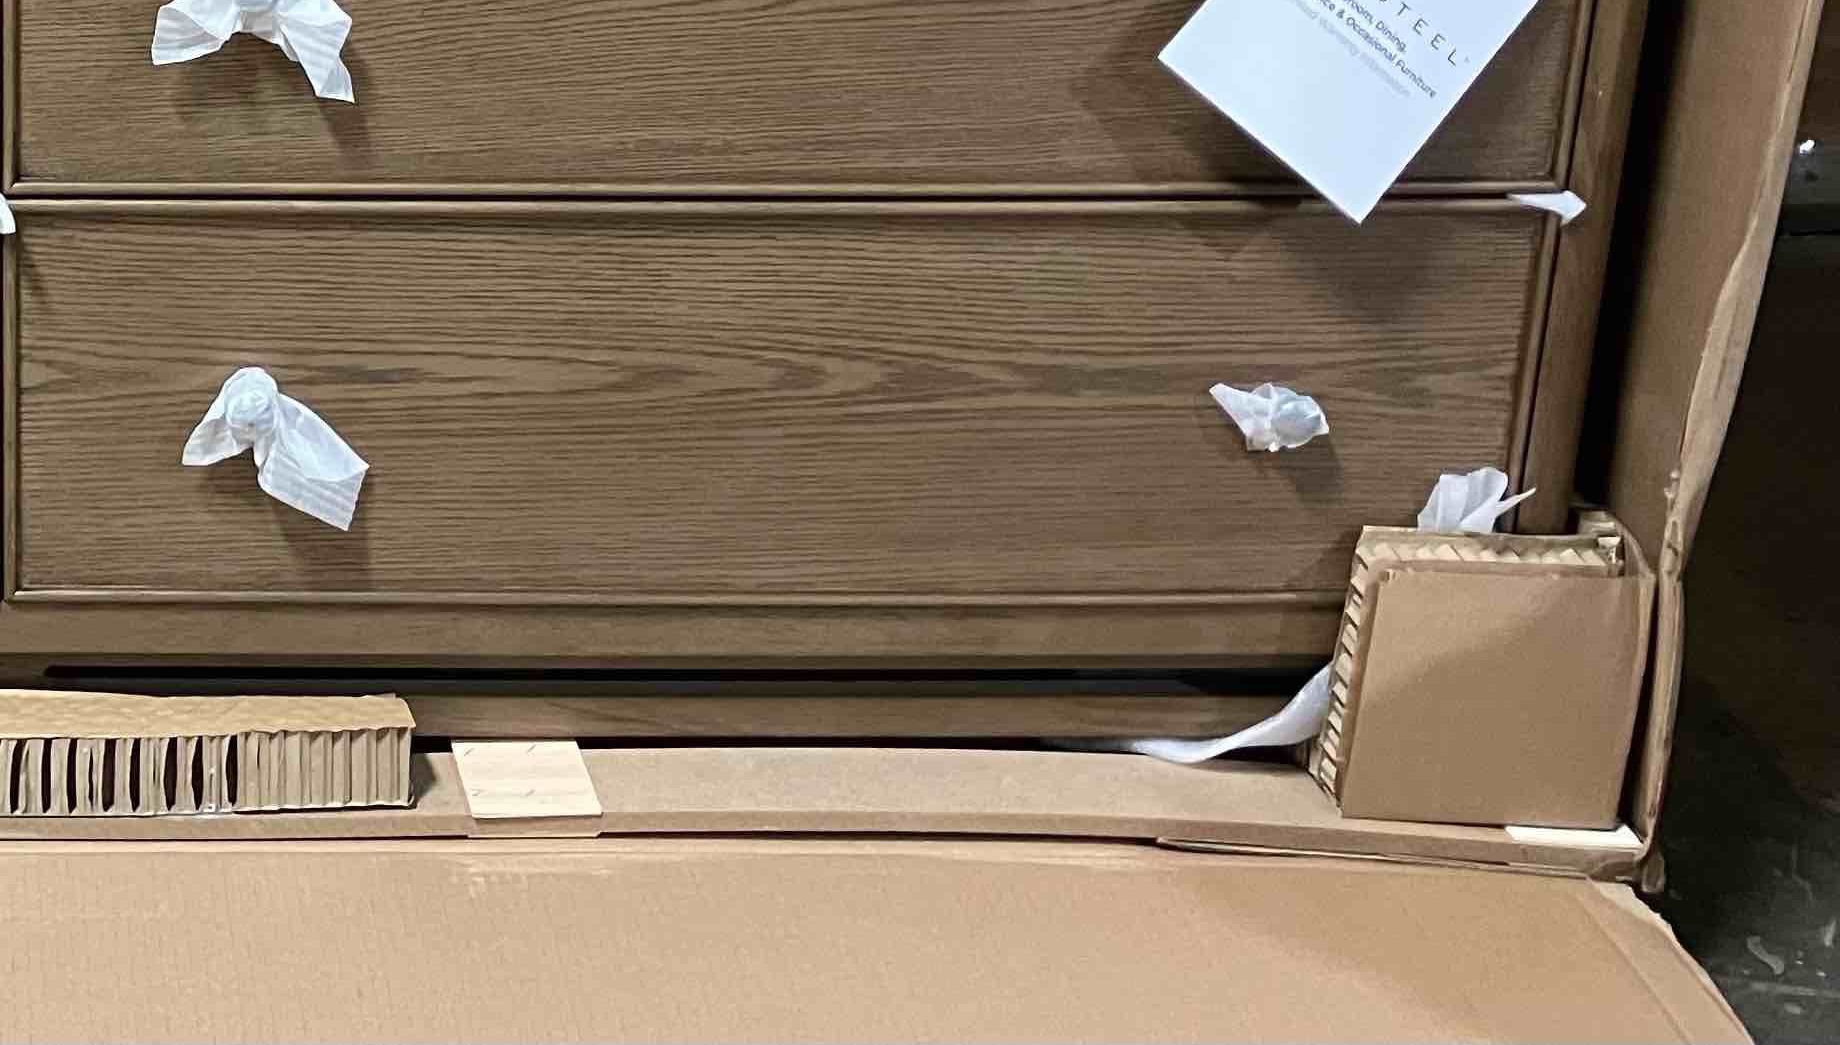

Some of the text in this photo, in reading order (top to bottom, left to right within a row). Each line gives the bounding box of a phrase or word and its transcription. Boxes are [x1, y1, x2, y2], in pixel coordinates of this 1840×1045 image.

[1335, 8, 1345, 19] &
[1345, 16, 1397, 62] Occasional
[1395, 58, 1437, 98] Furniture
